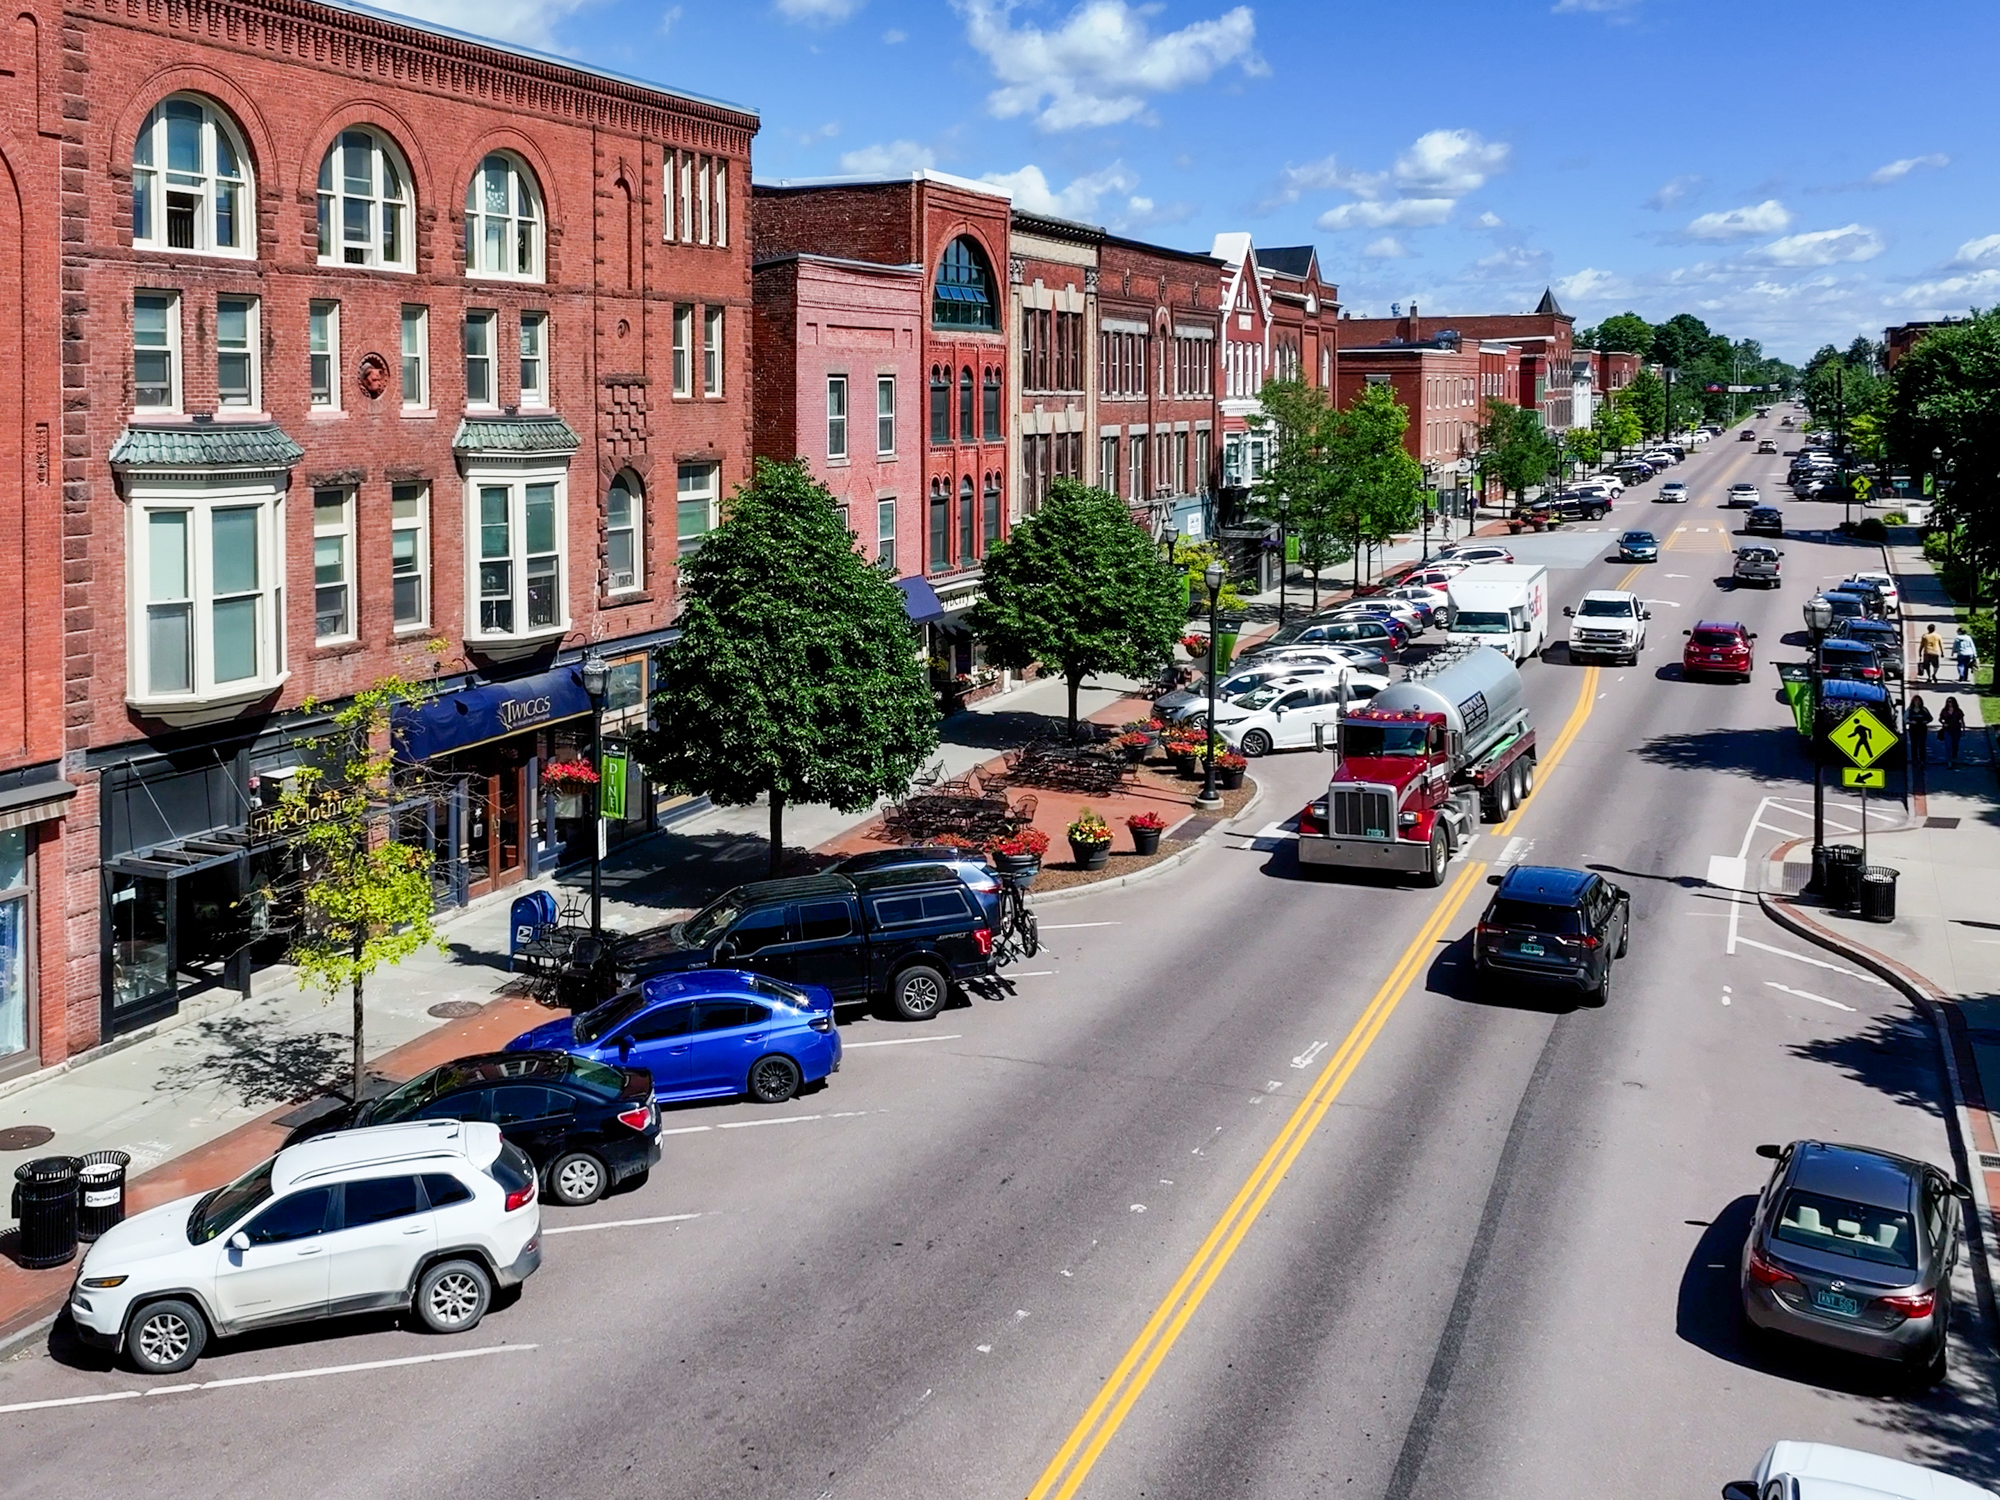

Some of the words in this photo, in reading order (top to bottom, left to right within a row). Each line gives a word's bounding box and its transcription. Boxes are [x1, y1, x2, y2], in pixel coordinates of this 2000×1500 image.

[938, 590, 971, 611] ayberry
[608, 763, 618, 808] DINE
[254, 814, 289, 837] The
